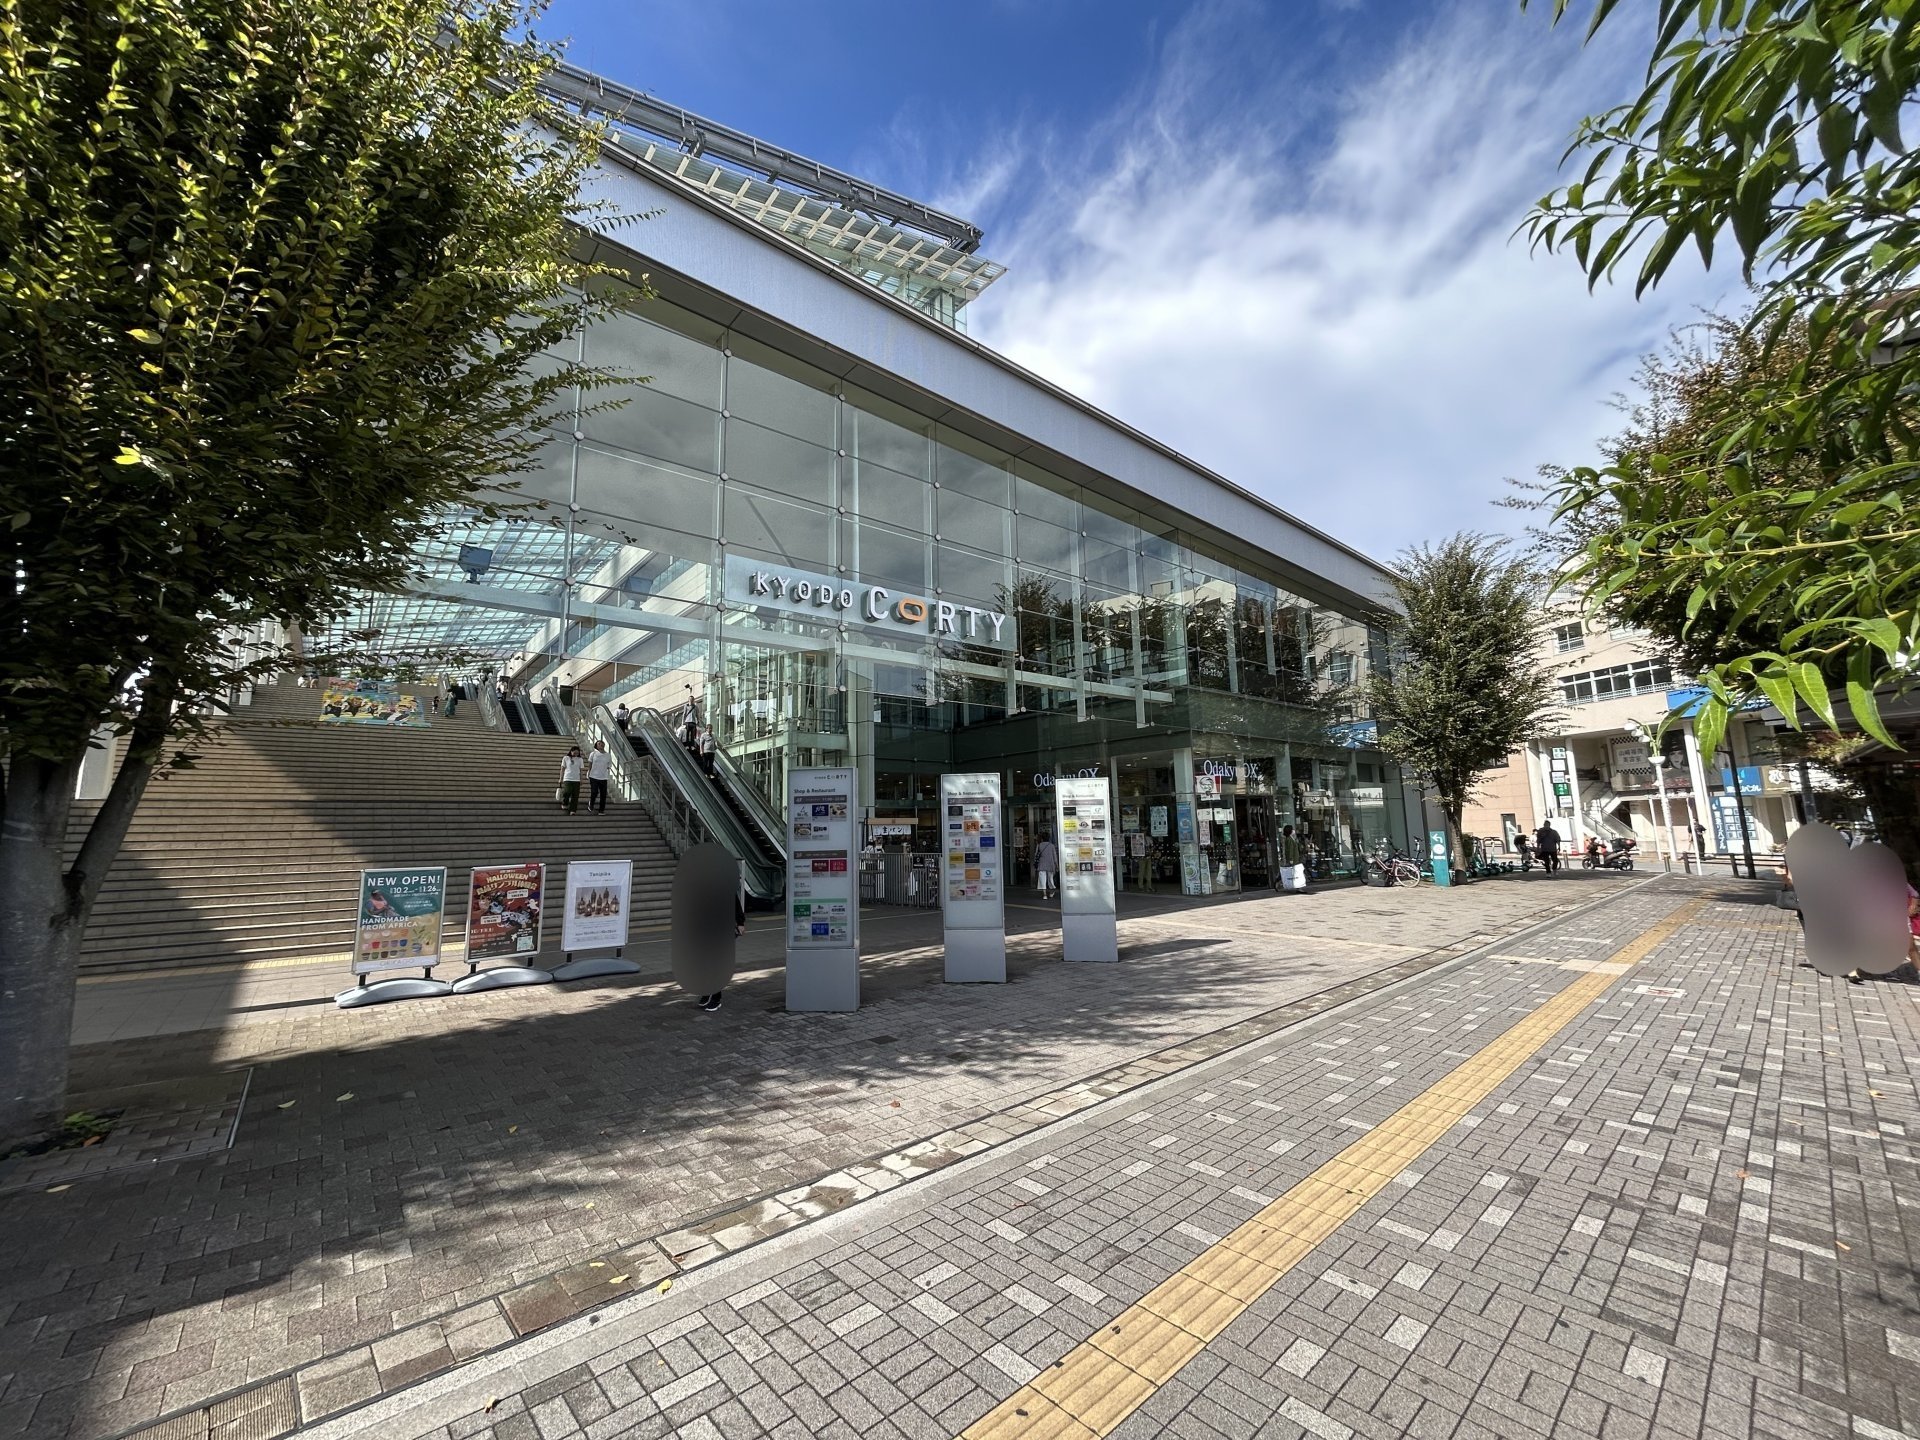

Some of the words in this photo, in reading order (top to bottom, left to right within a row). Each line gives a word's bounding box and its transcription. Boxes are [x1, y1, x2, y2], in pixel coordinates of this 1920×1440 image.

[754, 570, 853, 609] KYODO
[866, 586, 1006, 642] CORTY
[1203, 760, 1237, 781] Odaky
[1033, 772, 1076, 787] Oda
[367, 876, 397, 887] NEW
[401, 875, 440, 885] OPEN!
[486, 873, 529, 884] HALLOWEEN
[362, 916, 409, 925] HANDMADE
[388, 921, 418, 929] AFRICA
